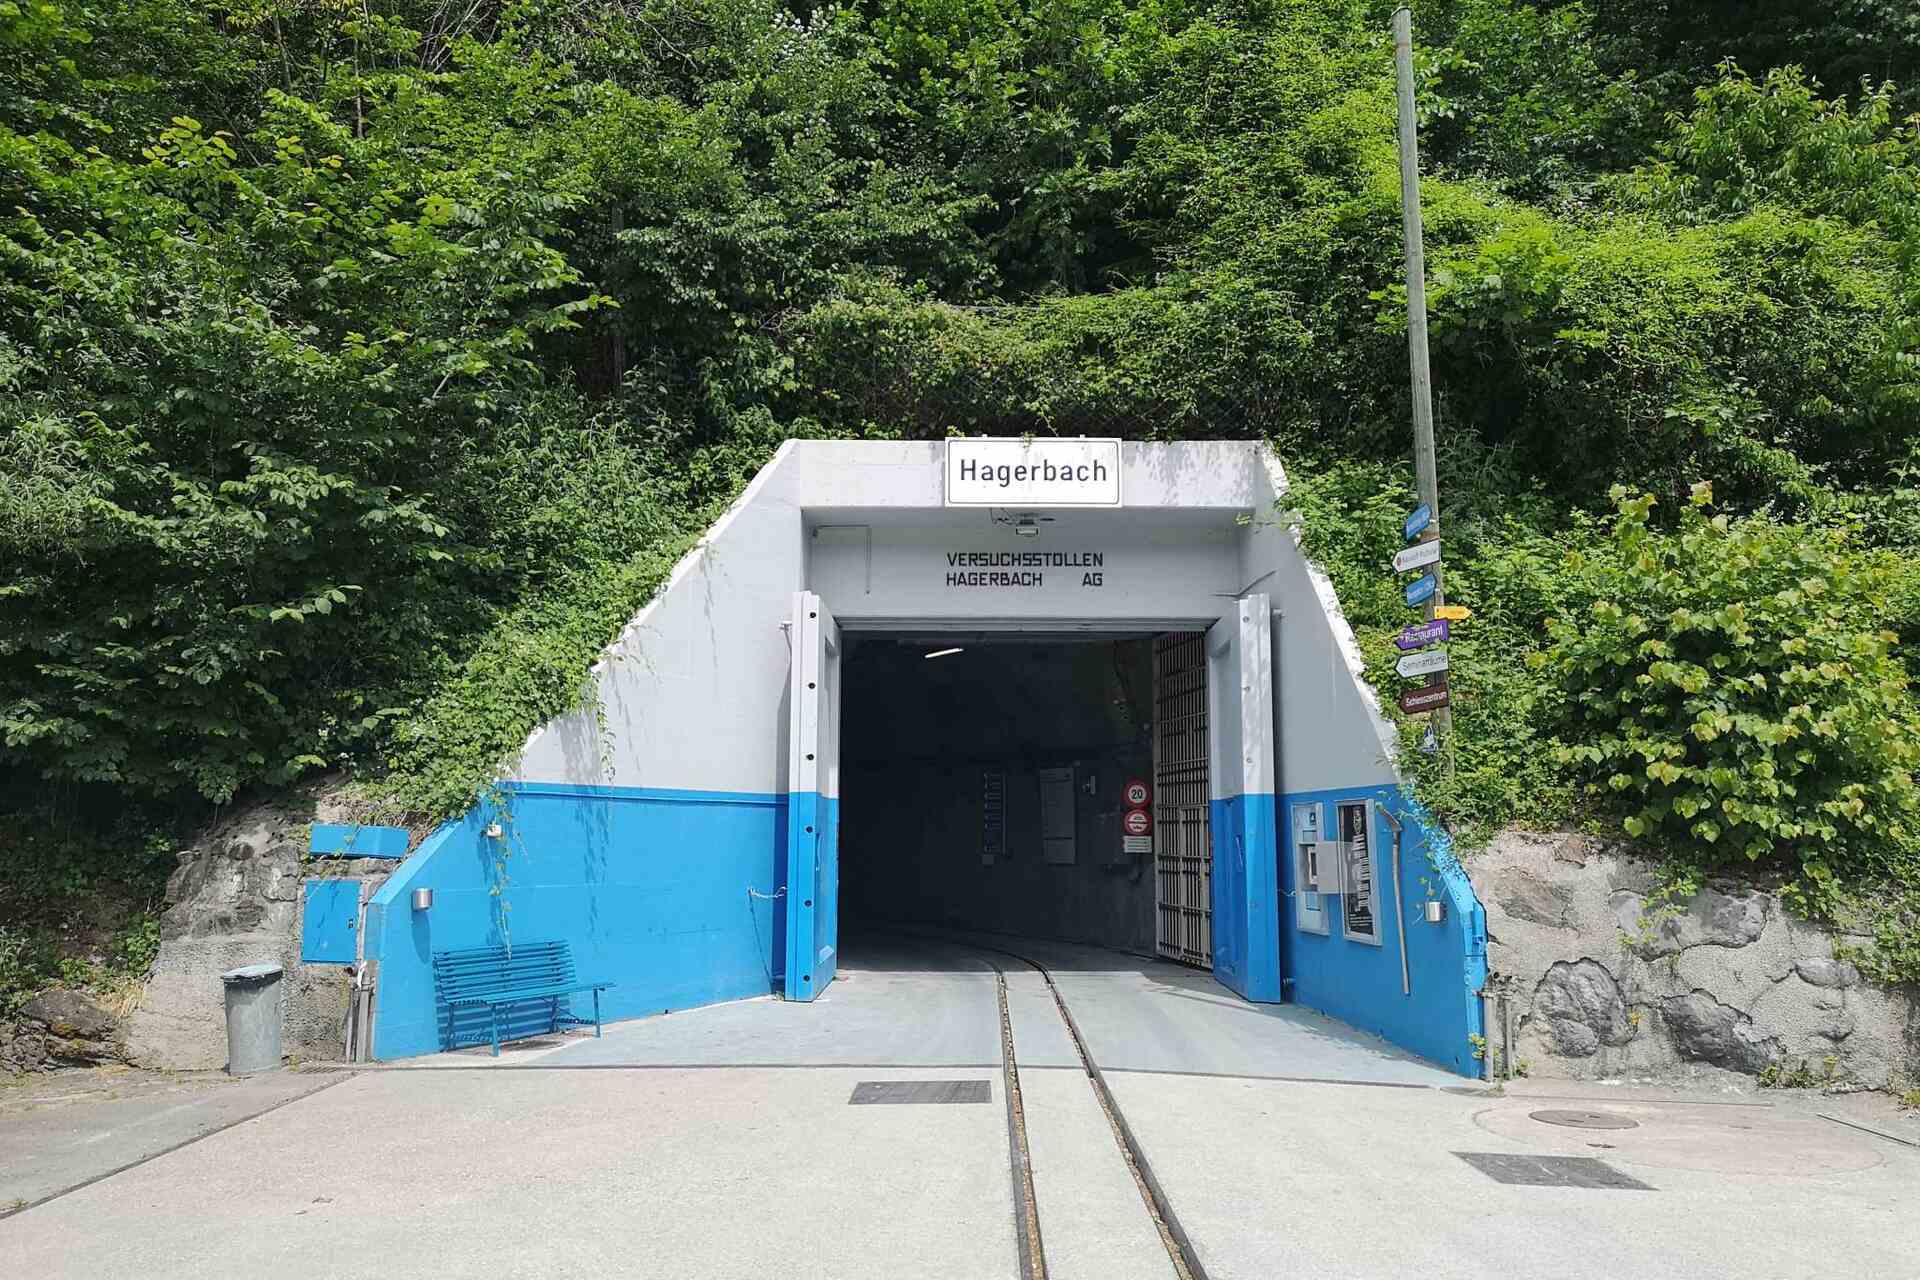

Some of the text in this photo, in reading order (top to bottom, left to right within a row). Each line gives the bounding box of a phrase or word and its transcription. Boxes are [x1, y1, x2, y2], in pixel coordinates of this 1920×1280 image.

[961, 459, 1106, 487] Hagerbach
[947, 552, 1103, 567] VERSUCHSSTOLLEN
[947, 572, 1103, 587] HAGERBACH AG
[1404, 624, 1443, 643] Restaurant
[1131, 789, 1143, 800] 20
